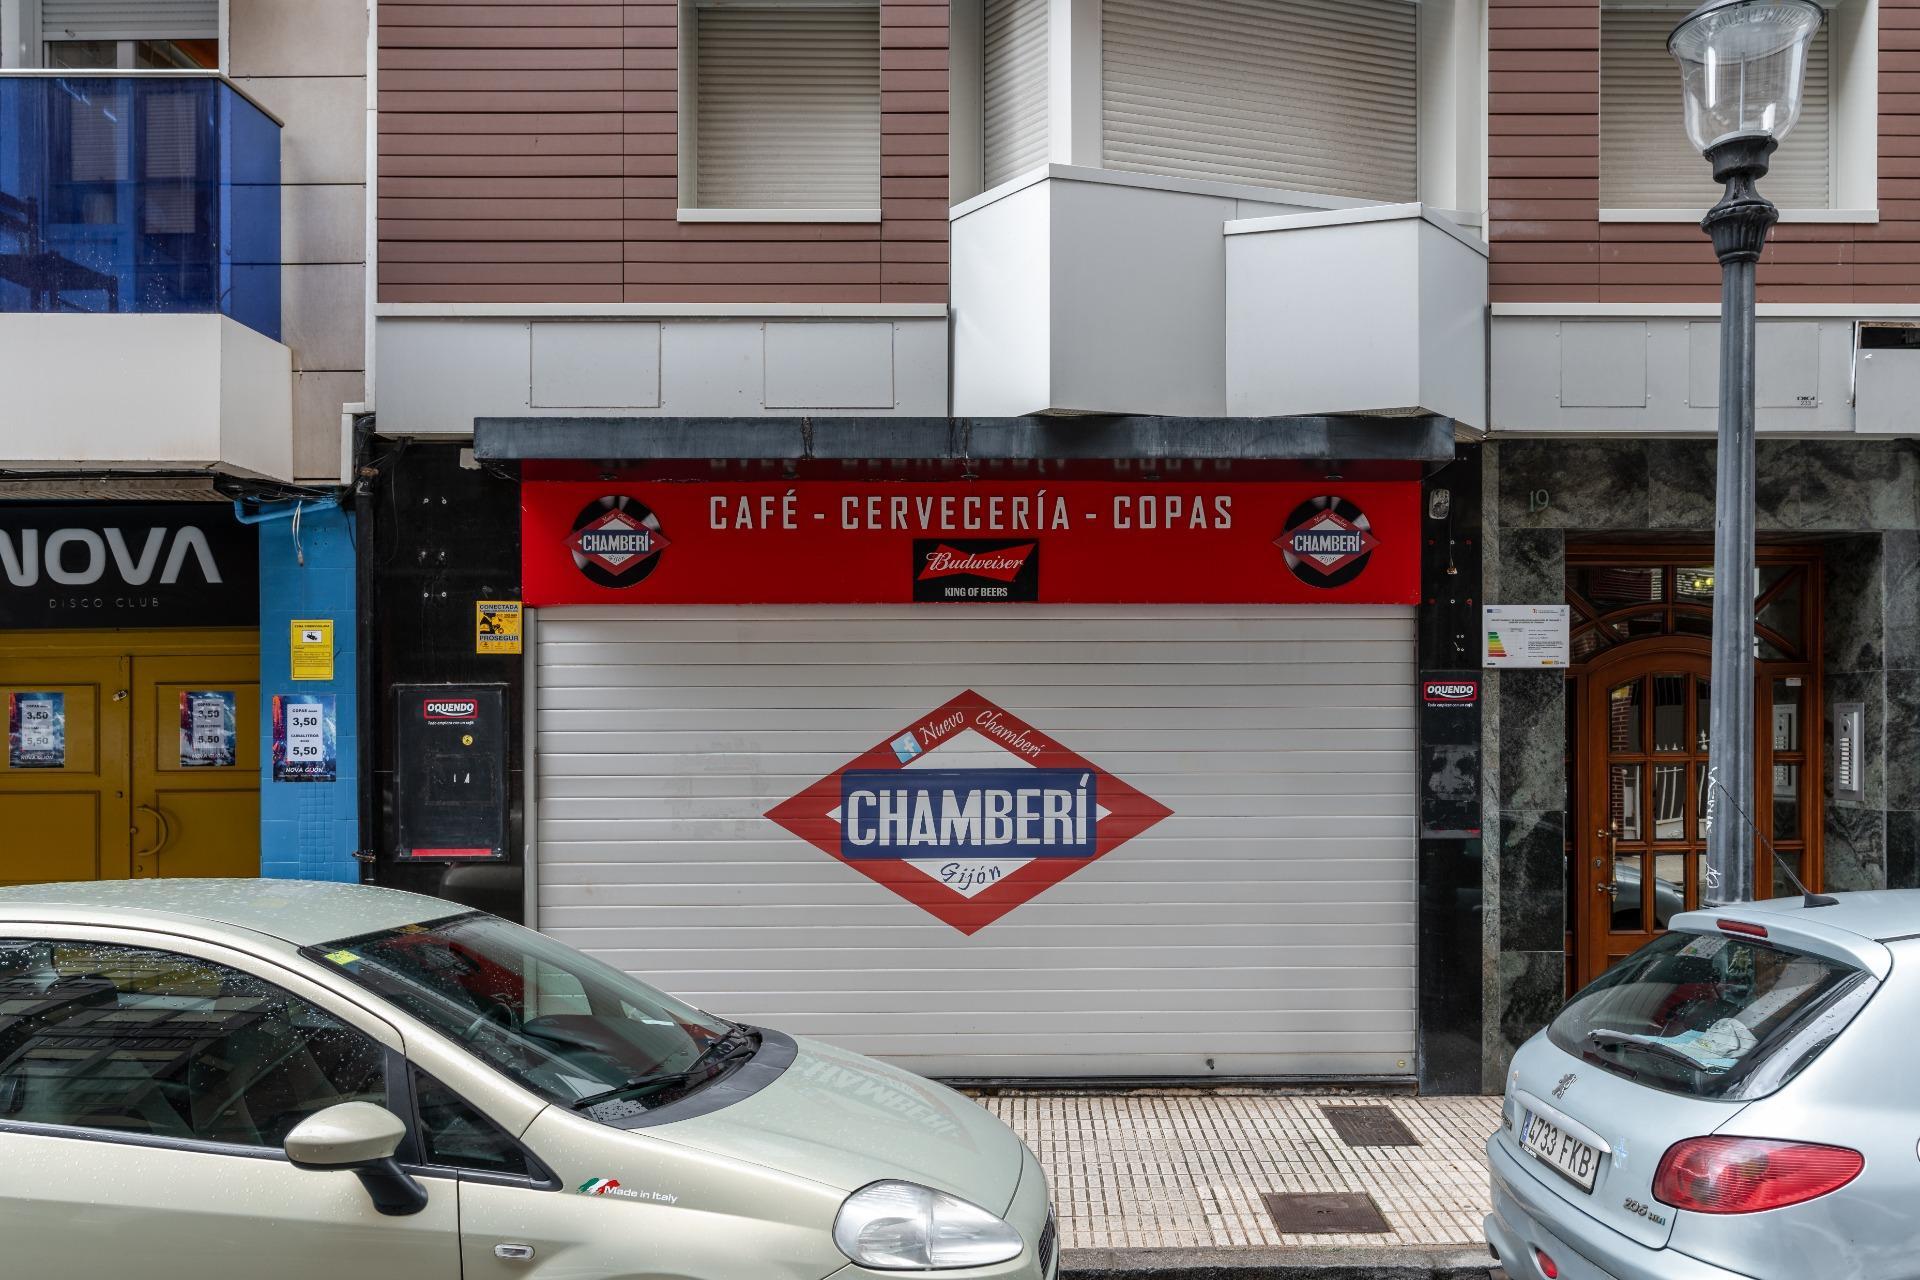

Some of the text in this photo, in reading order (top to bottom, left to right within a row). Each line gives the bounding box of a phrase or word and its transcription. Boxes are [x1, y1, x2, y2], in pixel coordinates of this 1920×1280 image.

[711, 489, 797, 529] CAFÉ
[841, 489, 1070, 530] CERVECERÍA
[1114, 496, 1232, 529] COPAS
[1528, 489, 1549, 513] 19
[583, 530, 649, 551] CHAMBERÍ
[1294, 531, 1360, 551] CHAMBERÍ
[0, 525, 224, 587] NOVA
[926, 552, 1024, 571] Budweiser
[945, 587, 1008, 597] KING OF BEERS
[50, 597, 159, 609] DISCO CLUB
[1427, 685, 1474, 695] OQUENDO
[26, 711, 49, 720] 3,50
[427, 703, 475, 713] OQUENDO
[292, 717, 318, 727] 3,50
[919, 711, 964, 745] Nuevo
[26, 737, 49, 747] 5,50
[292, 746, 318, 757] 5,50
[847, 773, 1090, 846] CHAMBERÍ
[940, 862, 1001, 890] Gijón
[1528, 1114, 1558, 1156] 4733
[1558, 1135, 1593, 1178] FKB
[604, 1185, 678, 1203] Made in Italy
[1623, 1197, 1648, 1217] 206
